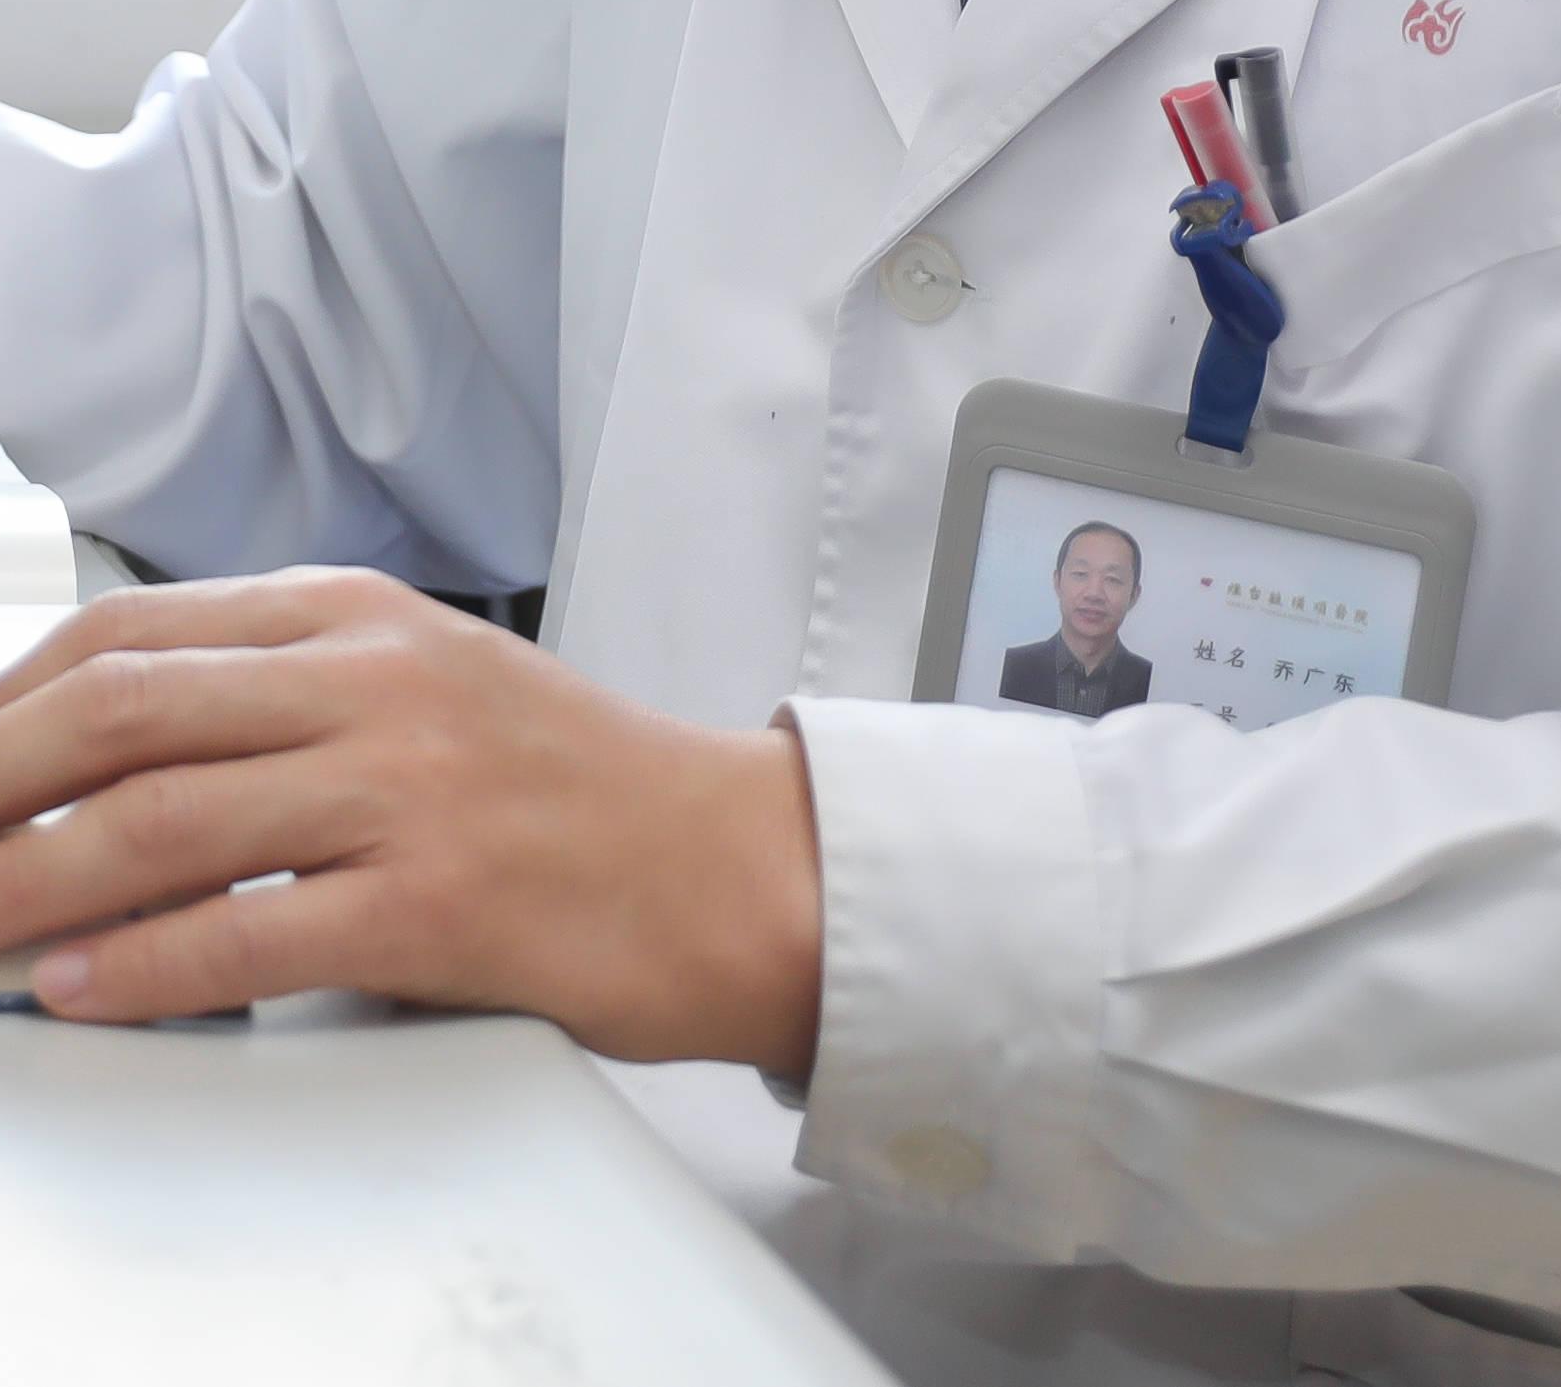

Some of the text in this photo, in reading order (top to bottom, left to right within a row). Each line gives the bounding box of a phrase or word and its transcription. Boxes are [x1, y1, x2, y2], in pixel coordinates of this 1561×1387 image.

[1193, 638, 1355, 694] 姓名 乔广东
[1191, 702, 1237, 723] 号
